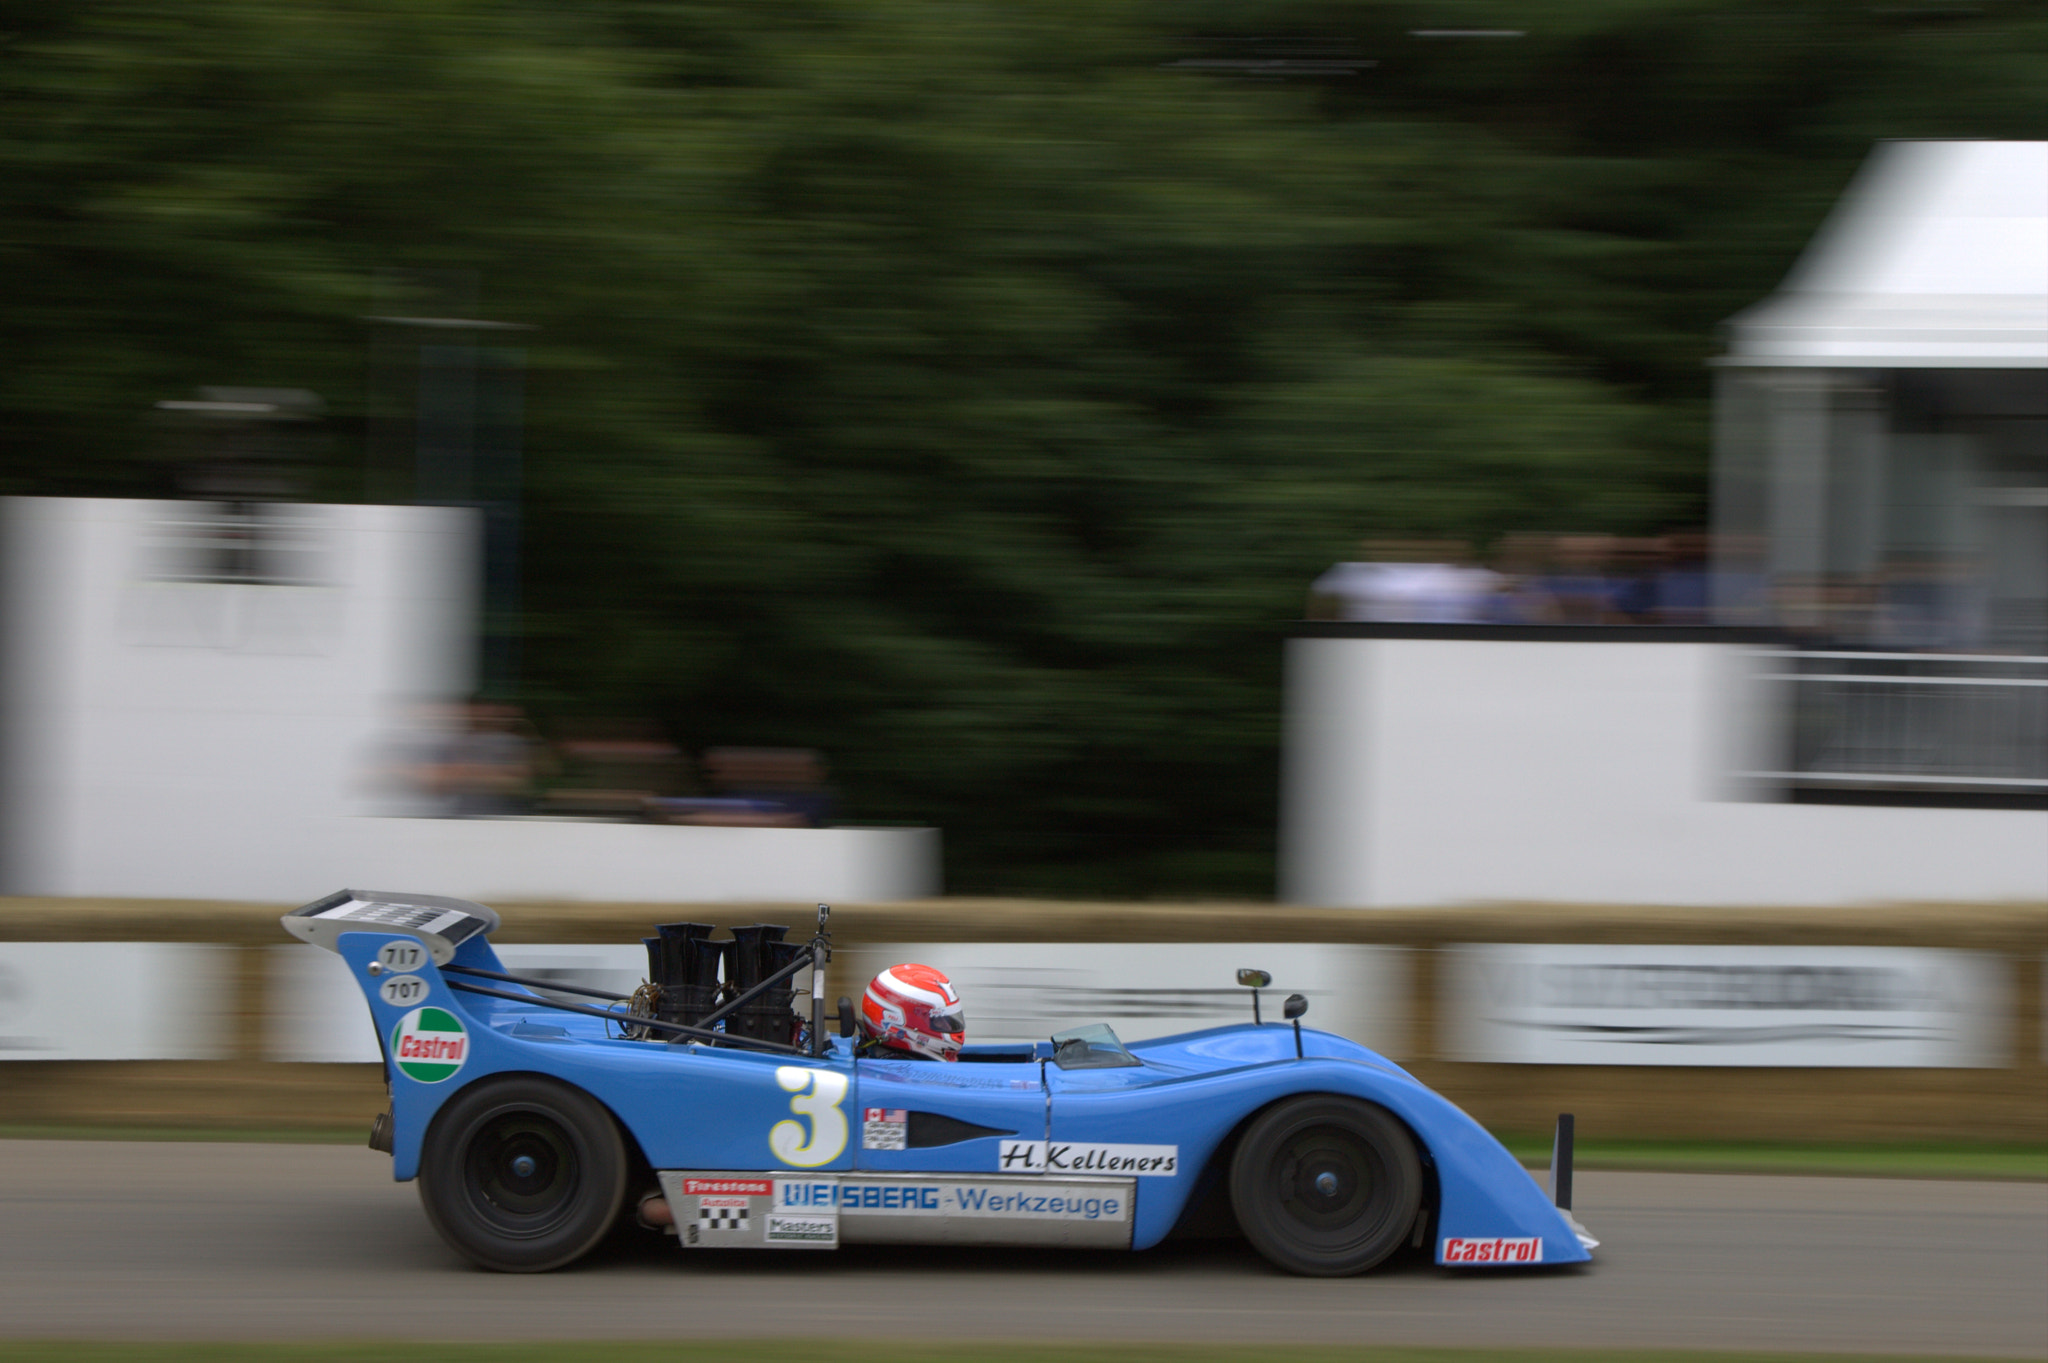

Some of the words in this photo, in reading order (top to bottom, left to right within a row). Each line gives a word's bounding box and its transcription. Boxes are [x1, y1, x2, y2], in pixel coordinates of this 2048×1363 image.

[385, 948, 420, 965] 717
[387, 981, 421, 1000] 707
[399, 1034, 466, 1060] Castrol
[768, 1065, 849, 1168] 3
[686, 1180, 768, 1194] Firestone
[769, 1218, 833, 1233] Masters
[1443, 1238, 1540, 1262] Castrol
